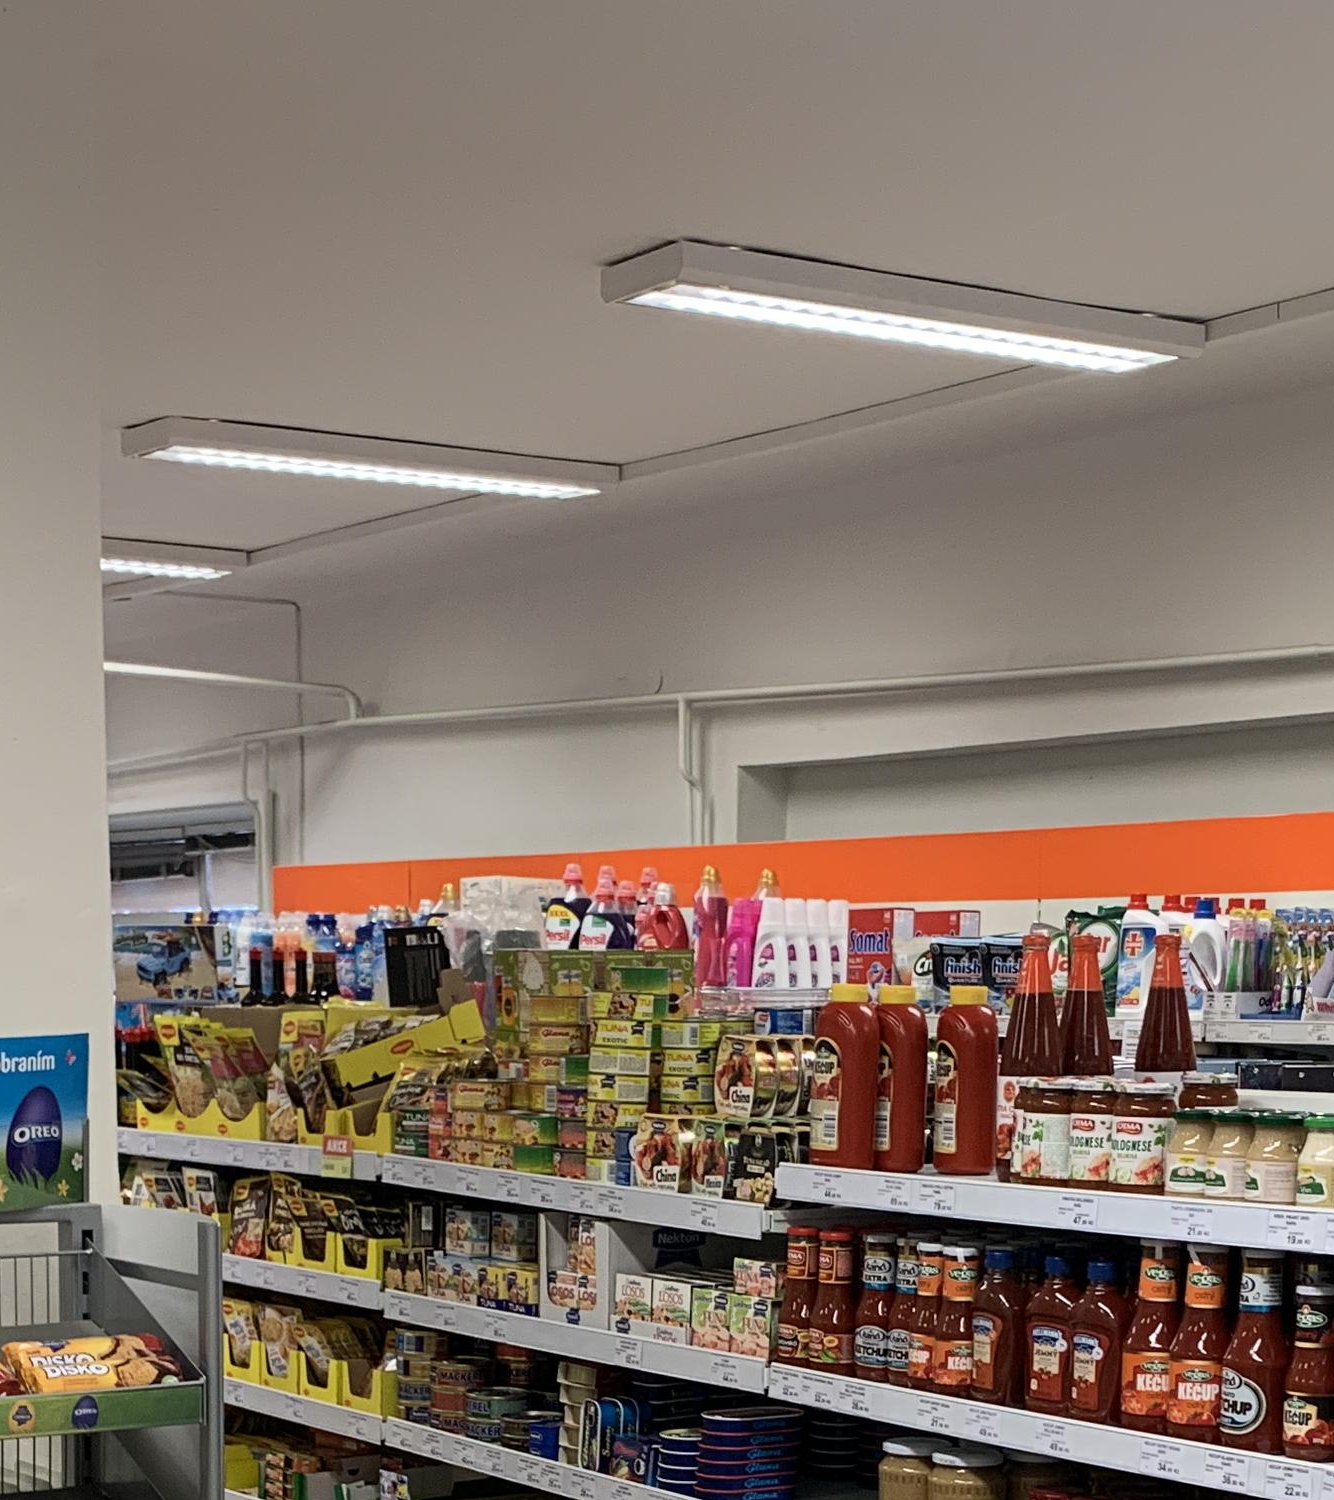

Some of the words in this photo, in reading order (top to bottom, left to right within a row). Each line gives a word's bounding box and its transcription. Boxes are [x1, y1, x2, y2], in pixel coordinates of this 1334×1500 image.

[580, 932, 607, 947] Persil
[849, 928, 890, 955] Somat
[944, 957, 982, 976] finish
[13, 1126, 59, 1143] OREO
[44, 1360, 111, 1380] DISKO
[1177, 1380, 1219, 1401] KEČUP
